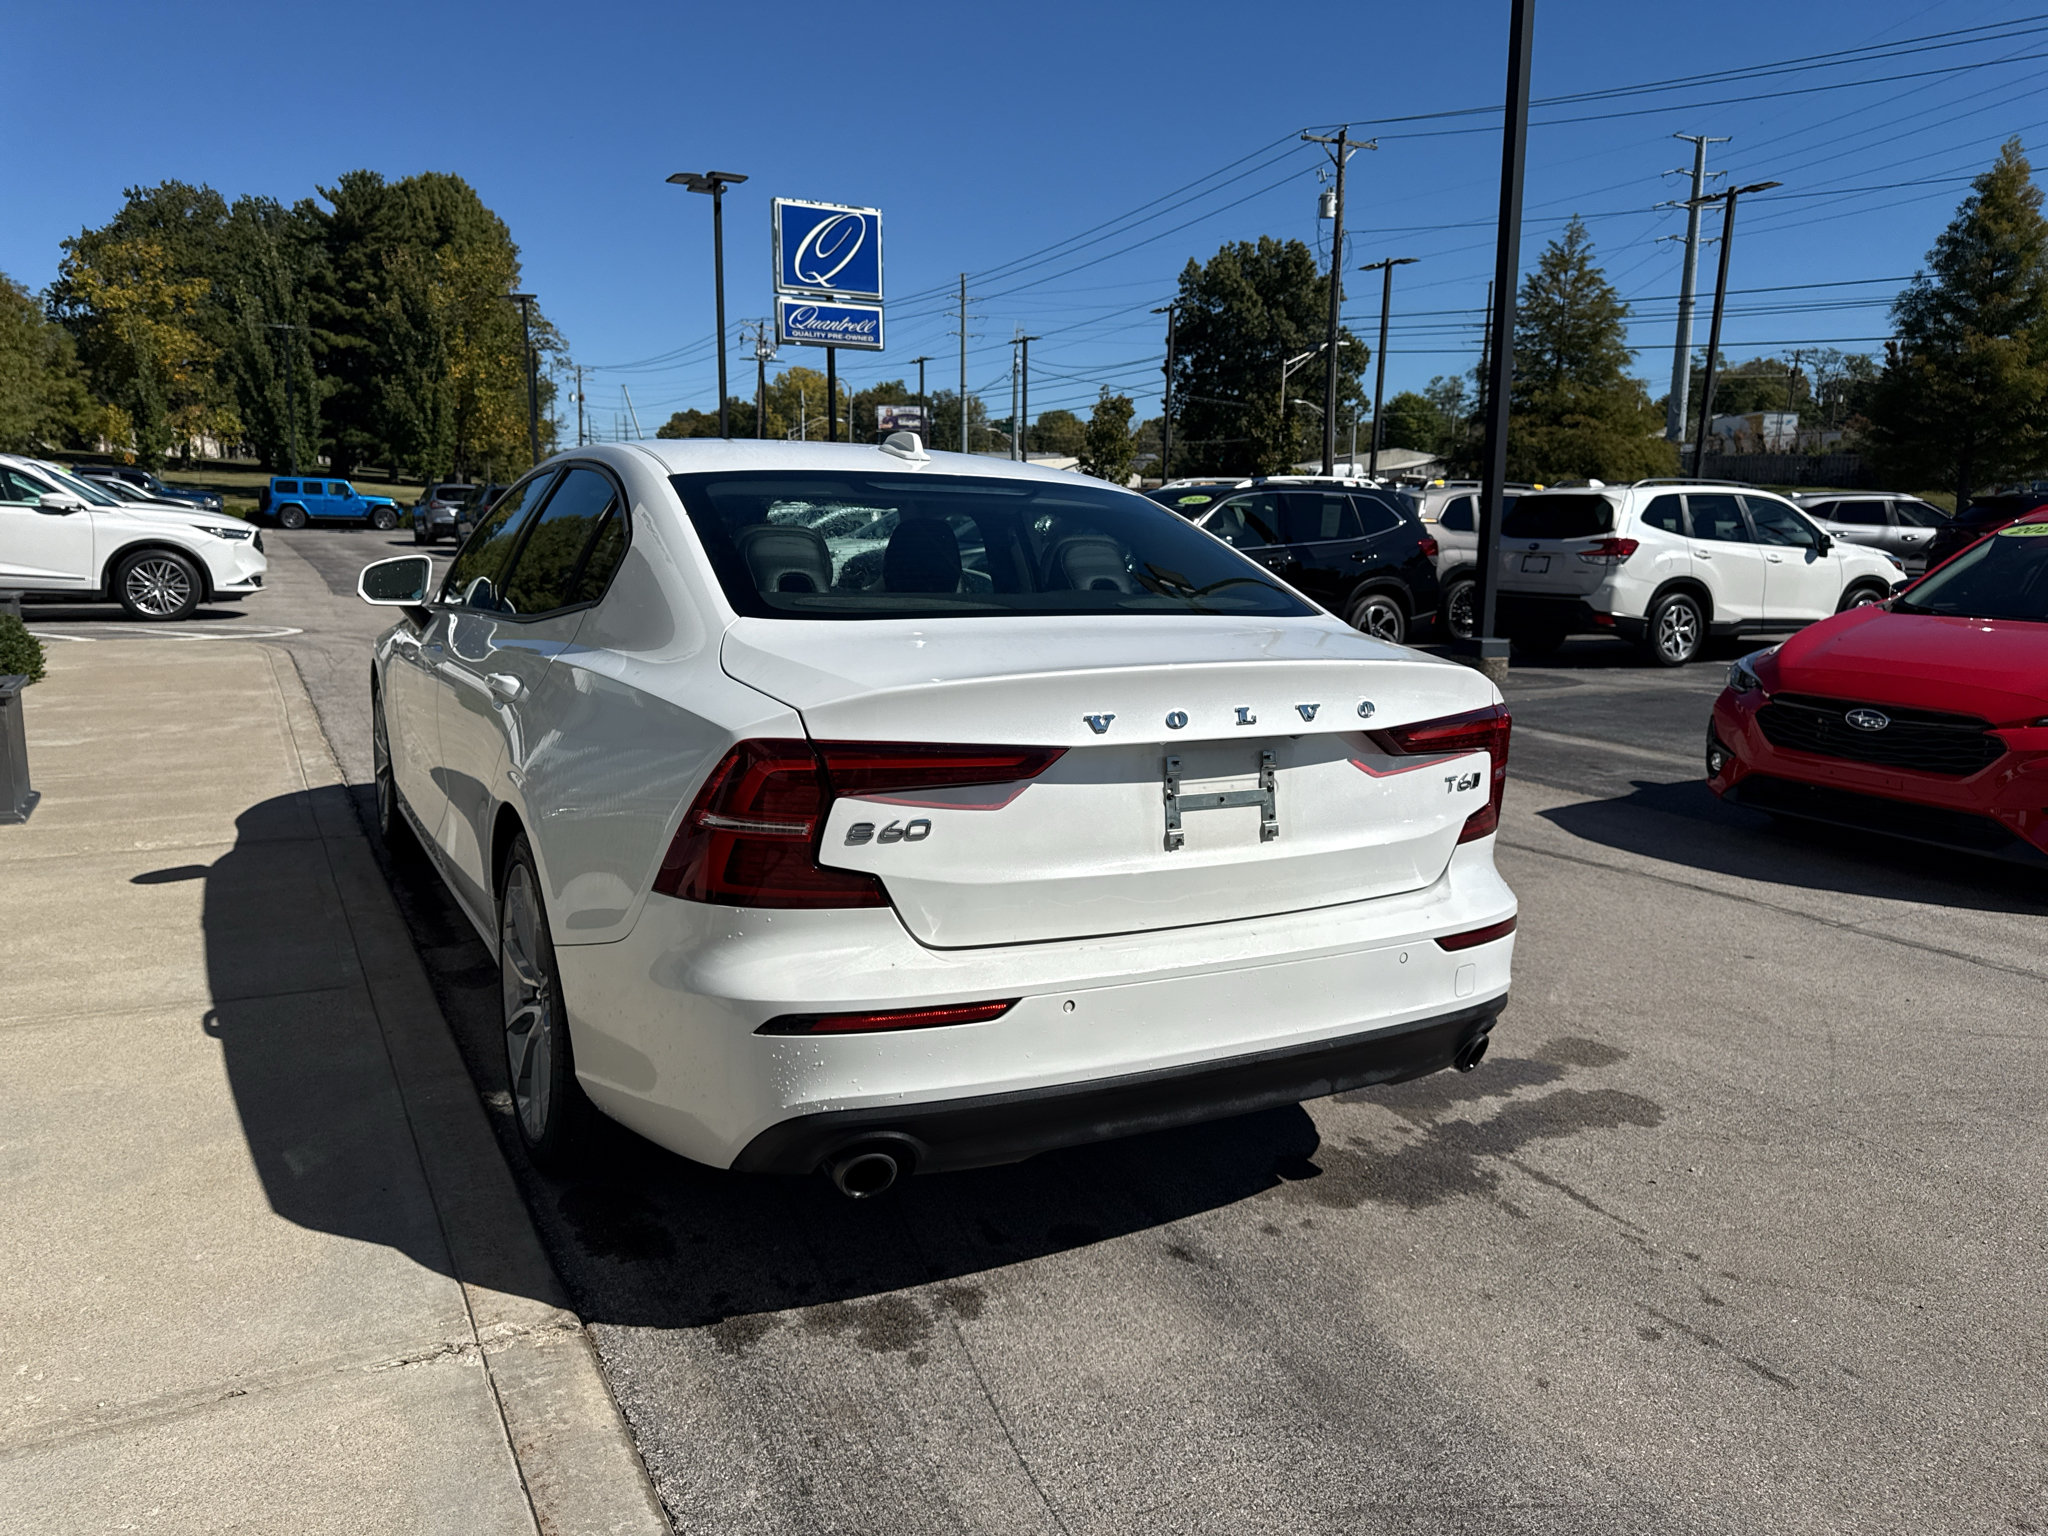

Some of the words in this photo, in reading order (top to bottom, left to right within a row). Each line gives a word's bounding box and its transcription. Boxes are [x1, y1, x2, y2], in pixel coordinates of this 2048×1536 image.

[794, 212, 867, 288] Q
[788, 305, 877, 334] Quantrell
[792, 330, 826, 339] QUALITY
[827, 332, 875, 342] PRE-OWNED
[1083, 700, 1375, 735] VOLVO
[844, 818, 932, 846] S60
